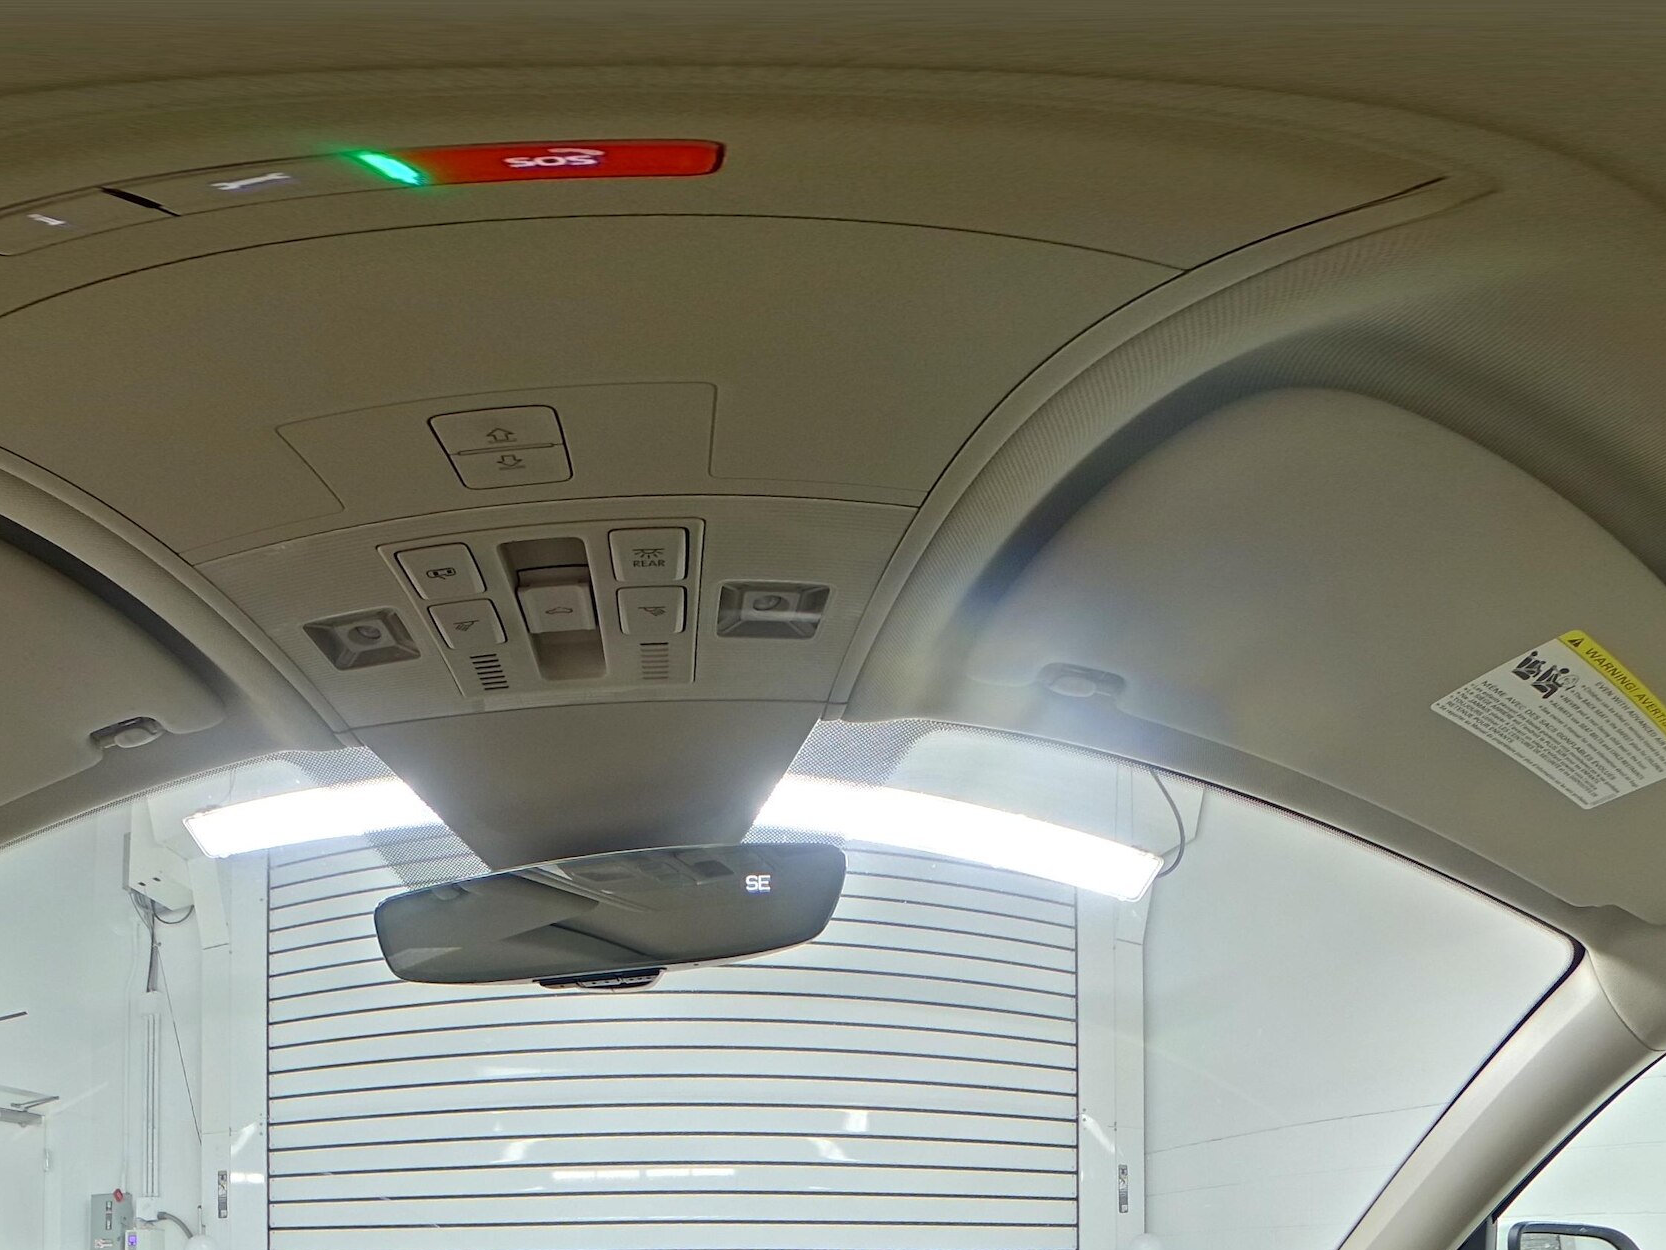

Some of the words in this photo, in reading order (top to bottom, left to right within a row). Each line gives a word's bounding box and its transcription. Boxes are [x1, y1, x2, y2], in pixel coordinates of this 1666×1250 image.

[504, 156, 598, 167] SOS
[1585, 648, 1639, 692] WARNING!
[745, 875, 771, 891] SE
